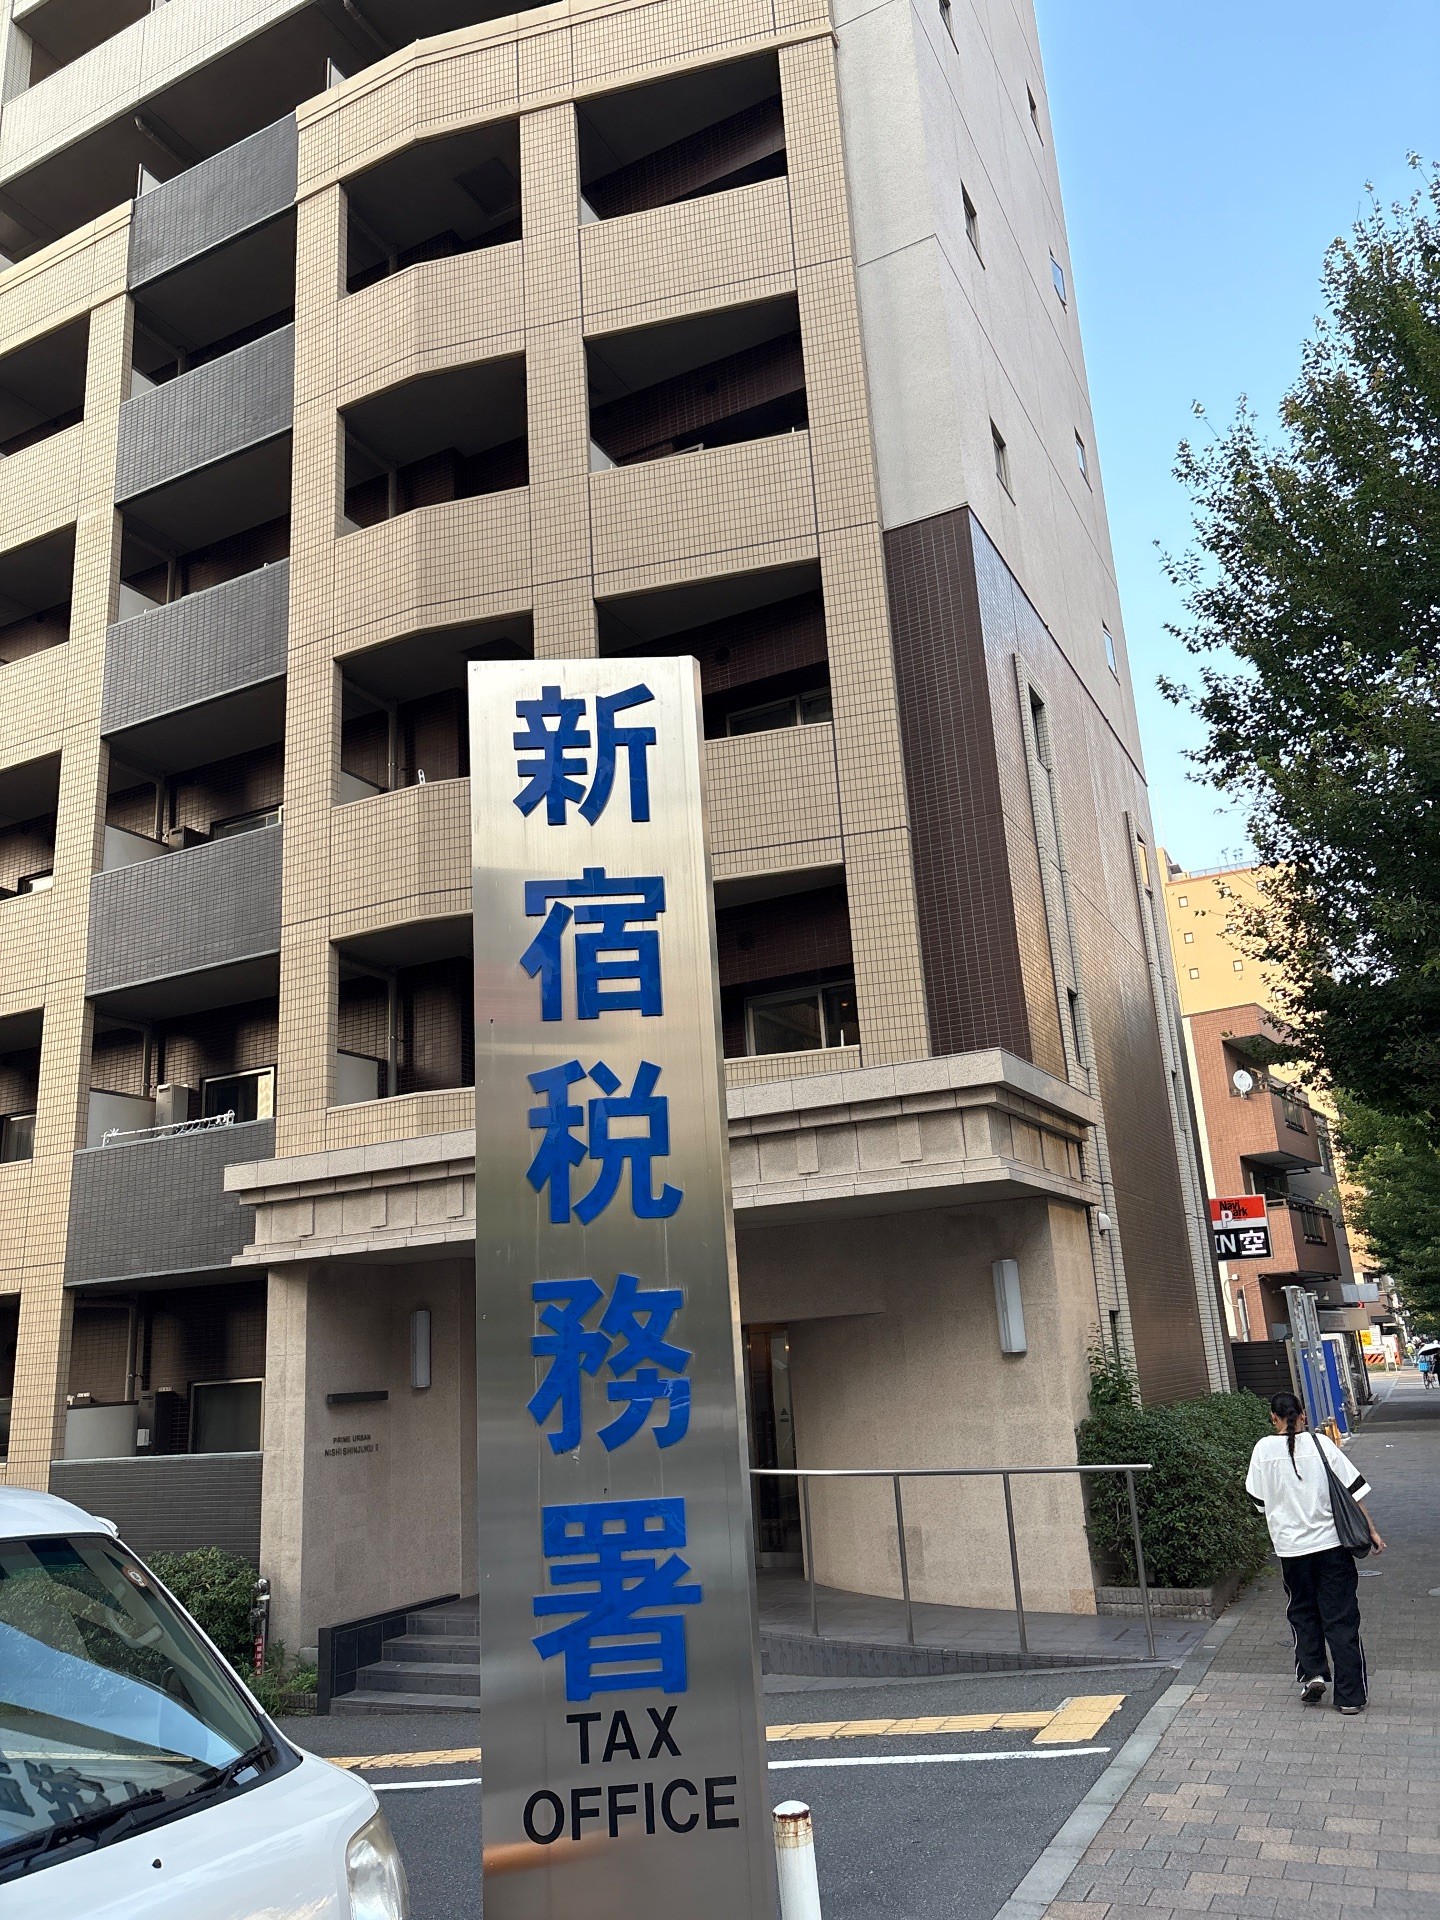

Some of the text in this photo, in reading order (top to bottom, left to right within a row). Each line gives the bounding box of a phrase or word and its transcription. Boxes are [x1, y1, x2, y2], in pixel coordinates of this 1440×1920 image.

[512, 683, 702, 1702] 新宿税務署
[1221, 1207, 1248, 1228] Park
[1239, 1230, 1267, 1255] 空
[333, 1434, 371, 1444] PRIME URBAN
[566, 1706, 682, 1764] TAX
[523, 1776, 739, 1845] OFFICE
